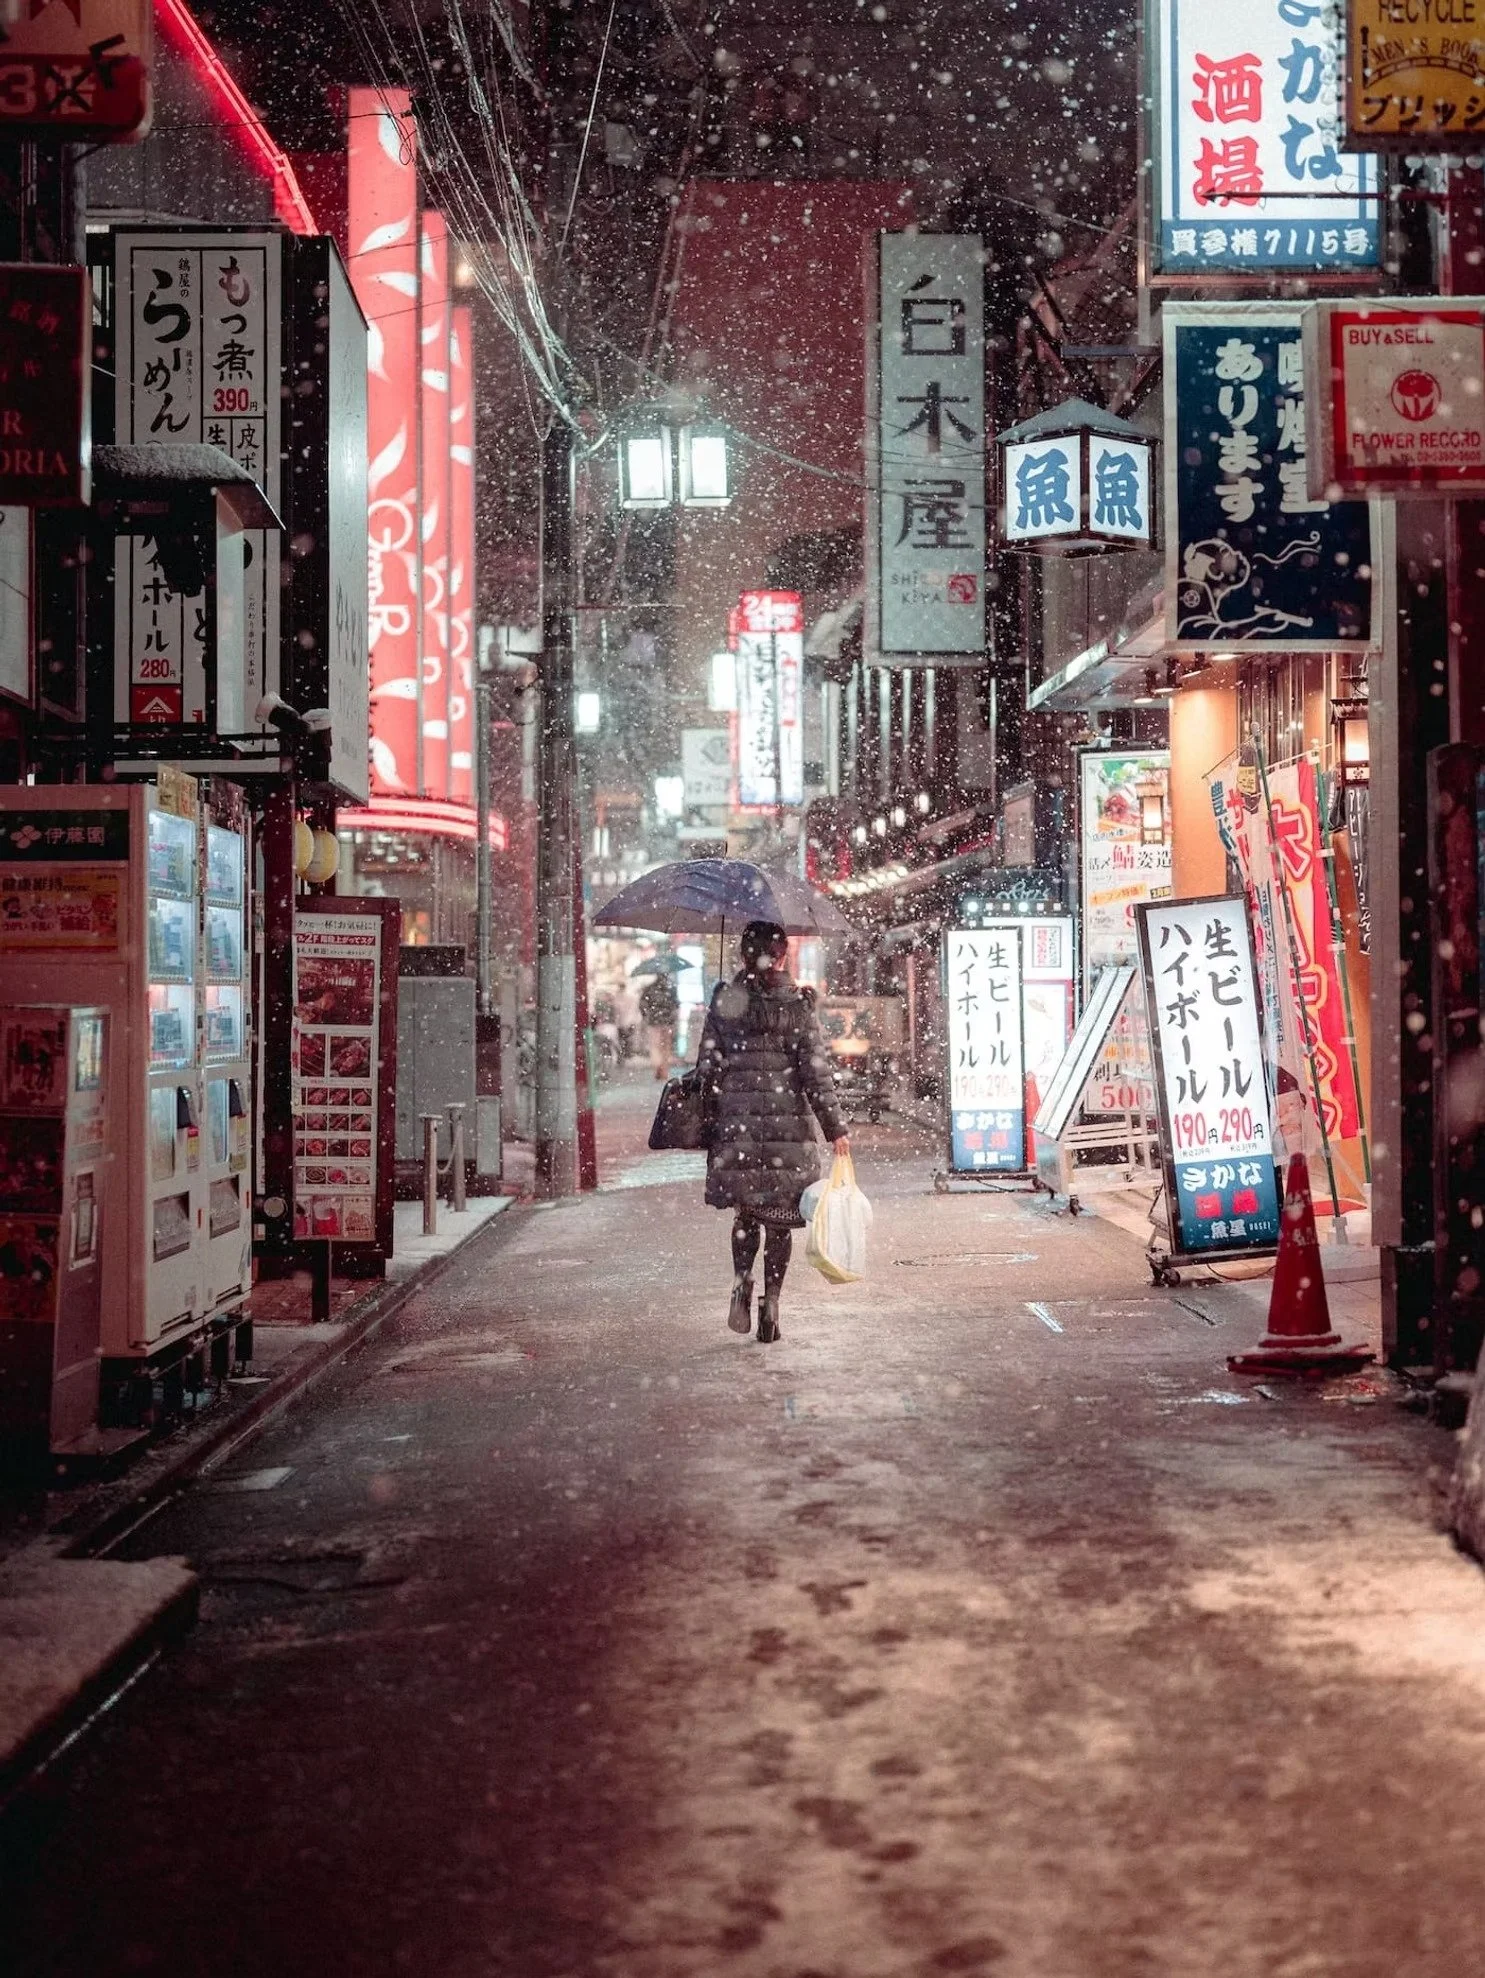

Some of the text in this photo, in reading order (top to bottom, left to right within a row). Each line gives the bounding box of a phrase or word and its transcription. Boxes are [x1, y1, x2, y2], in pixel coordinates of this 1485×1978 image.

[1191, 52, 1264, 207] 酒場
[143, 268, 191, 433] らーめん
[213, 255, 255, 382] もつ煮
[895, 273, 977, 550] 白木屋
[1214, 338, 1265, 522] あります
[1352, 431, 1481, 450] FLOWER RECORD
[1014, 447, 1075, 530] 魚
[1094, 448, 1143, 531] 魚
[44, 826, 106, 846] 伊藤園
[987, 941, 1011, 1067] 生ビール
[1160, 923, 1208, 1104] ハイボール
[1205, 918, 1253, 1098] 生ビール
[1182, 1161, 1263, 1192] さかな
